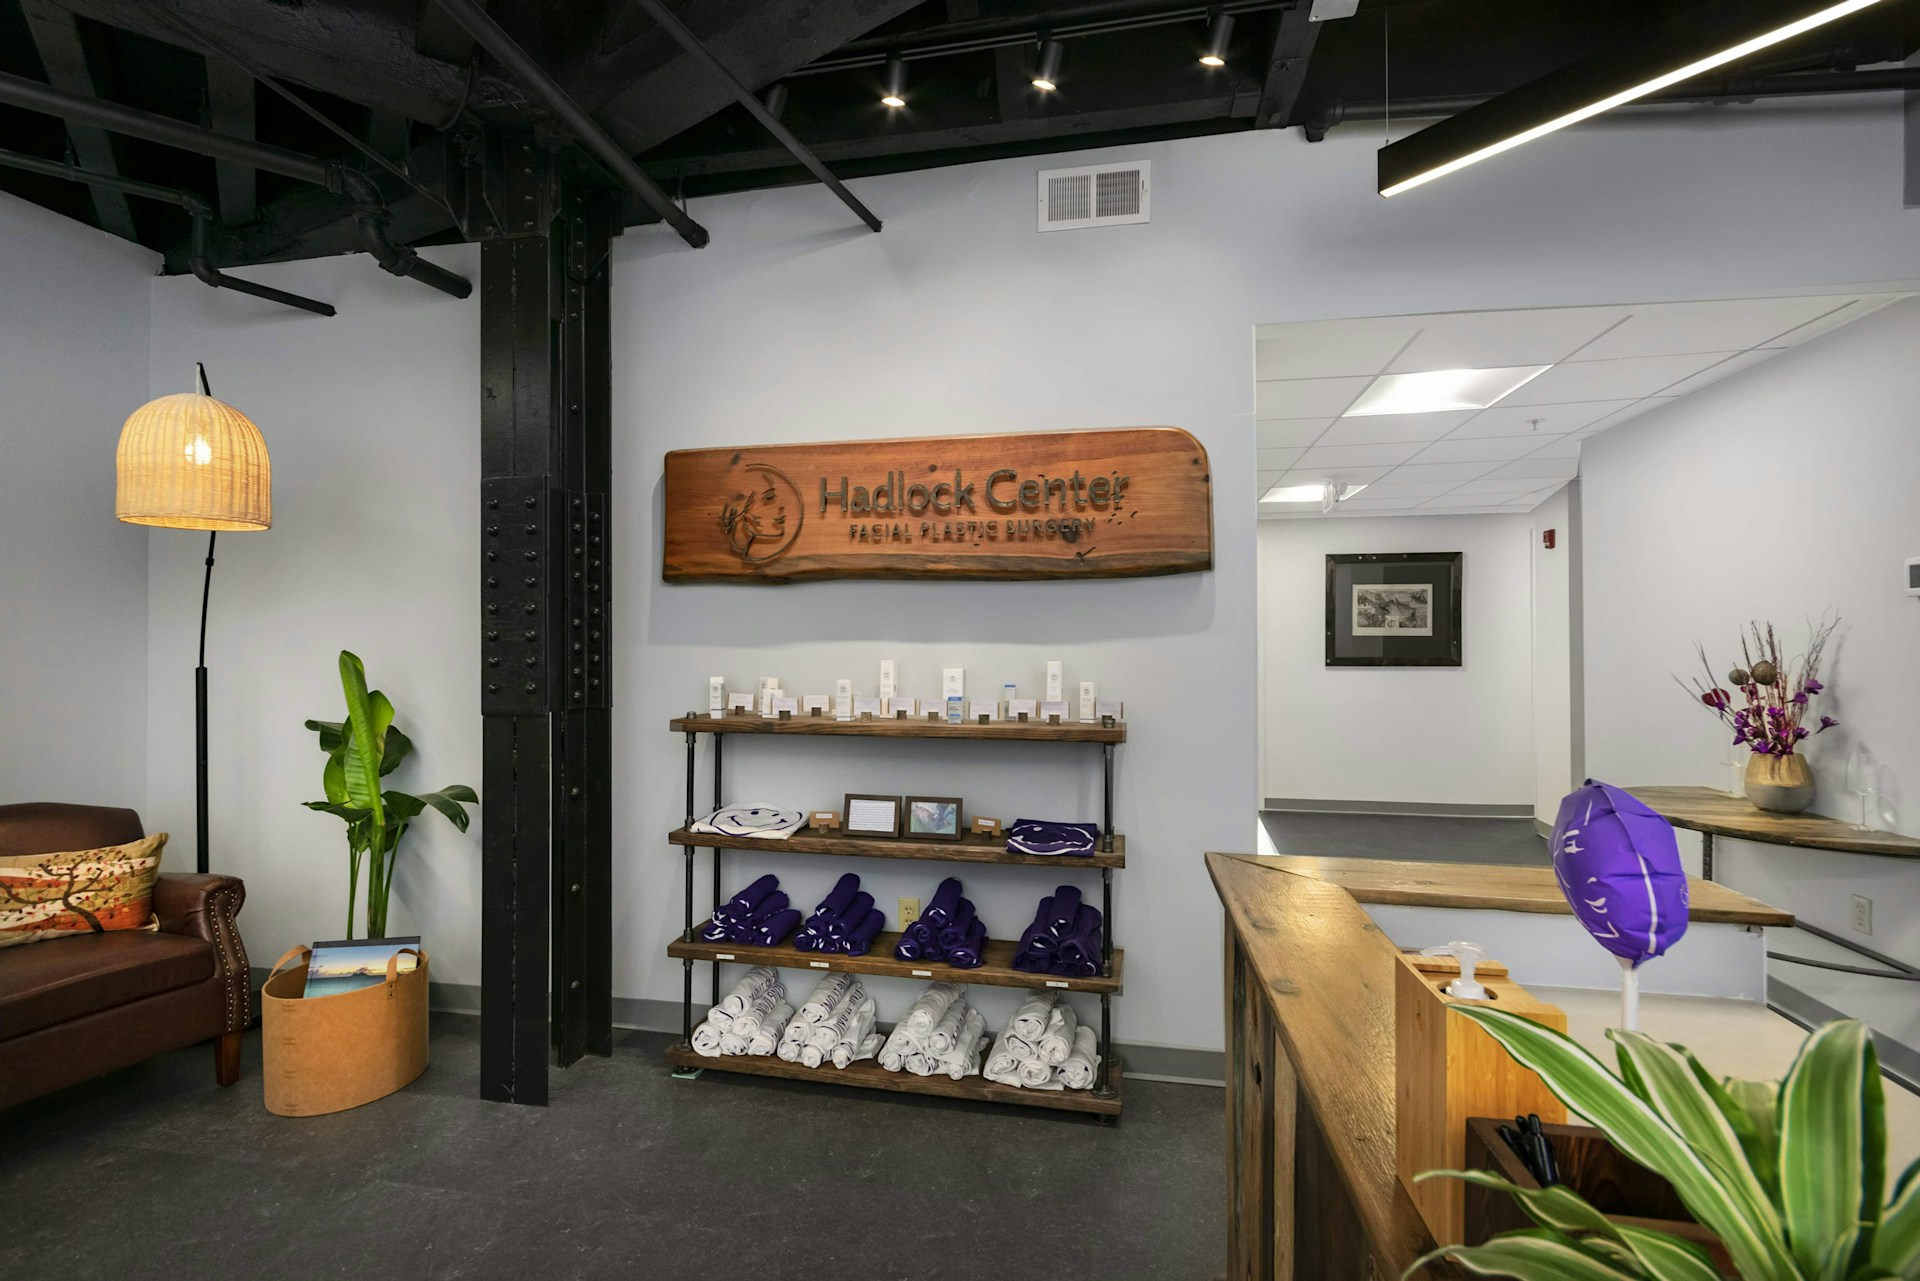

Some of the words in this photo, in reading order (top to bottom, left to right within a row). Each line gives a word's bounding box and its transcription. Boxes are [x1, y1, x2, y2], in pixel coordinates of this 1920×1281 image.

[819, 467, 976, 513] Hadlock
[984, 469, 1130, 508] Center
[849, 523, 911, 540] FACIAL
[920, 520, 998, 537] PLASTIC
[1006, 517, 1096, 534] SURGERY
